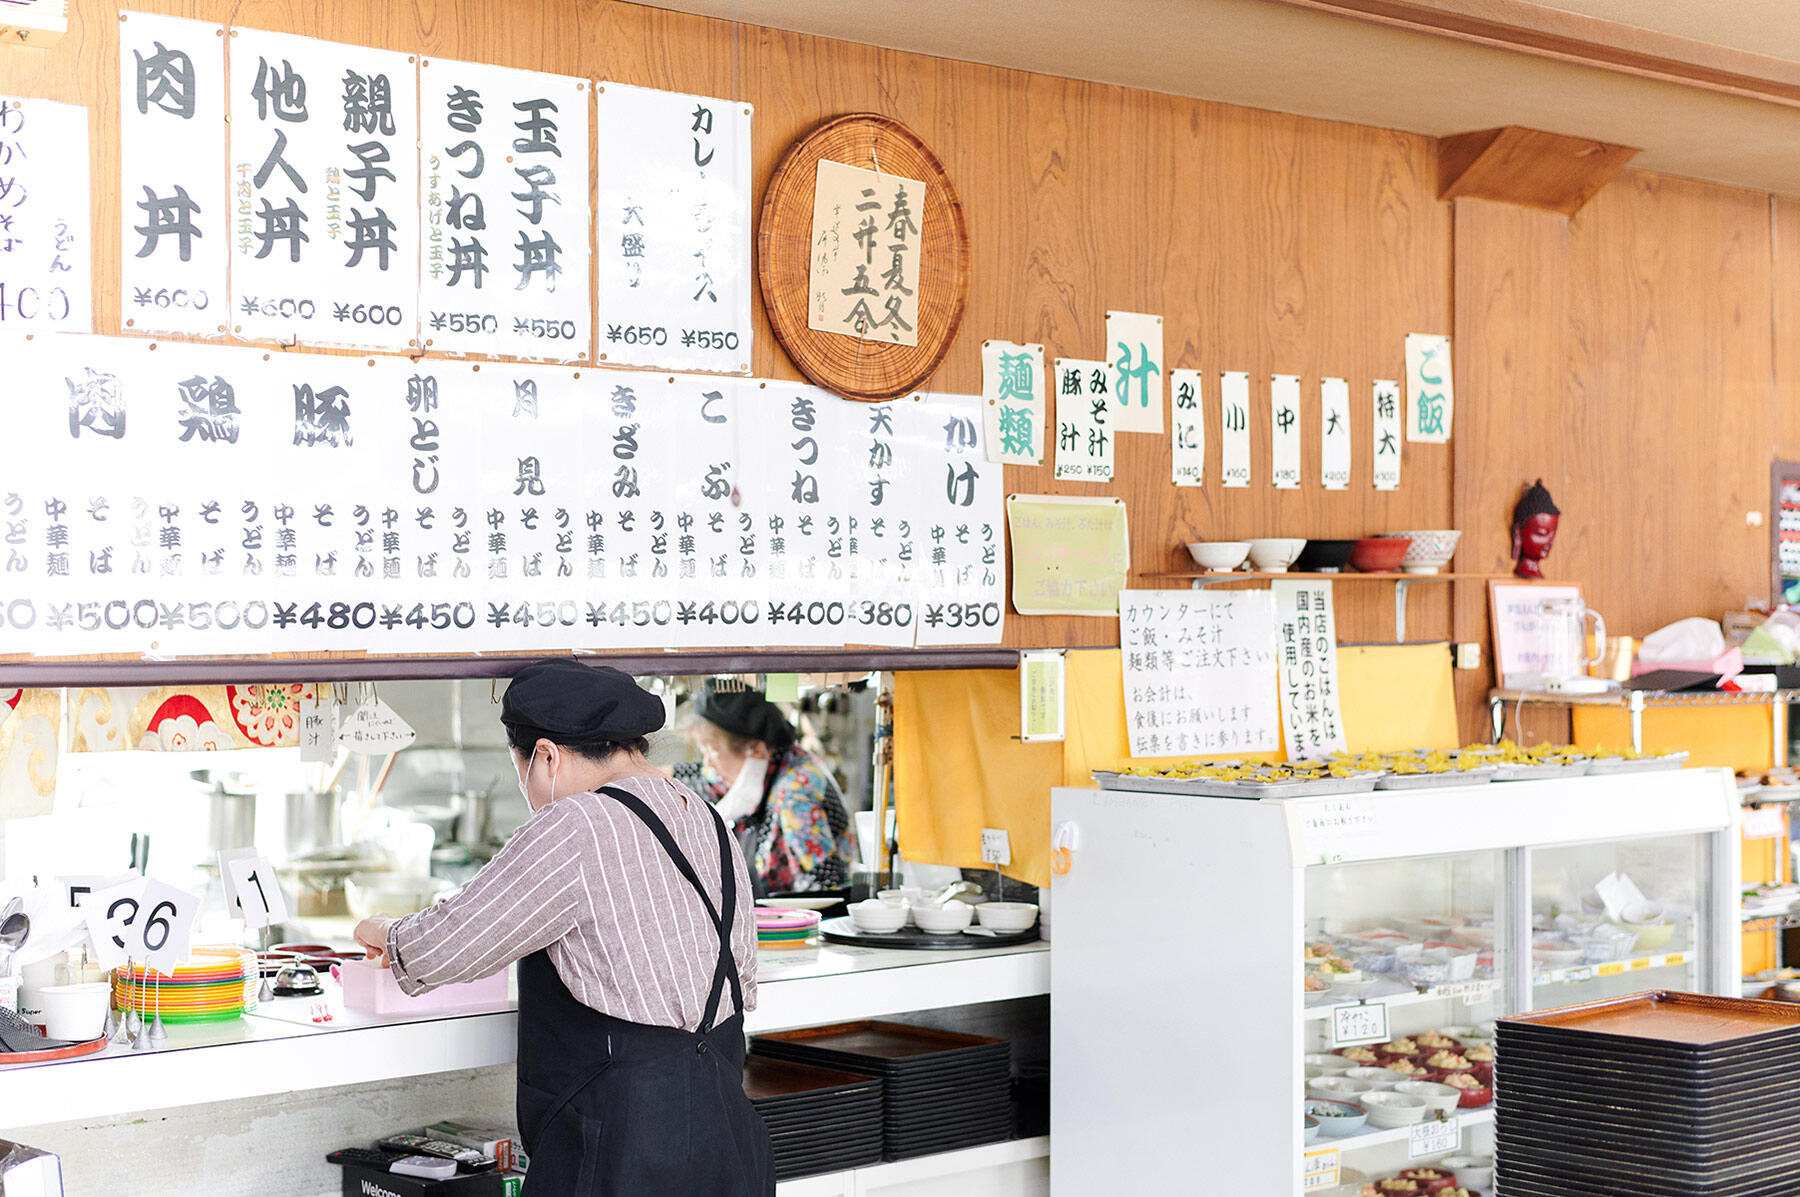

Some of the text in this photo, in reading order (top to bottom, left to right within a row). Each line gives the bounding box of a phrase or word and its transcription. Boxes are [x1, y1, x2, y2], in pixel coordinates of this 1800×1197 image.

[133, 41, 203, 262] 肉丼
[251, 56, 309, 262] 他人丼
[342, 69, 397, 271] 親子丼
[445, 85, 489, 289] きつね丼
[511, 98, 563, 293] 玉子丼
[49, 218, 72, 273] うどん
[879, 184, 918, 341] 春夏冬
[134, 287, 208, 310] ¥600
[241, 296, 316, 320] ¥600
[333, 303, 402, 325] ¥600
[430, 312, 497, 334] ¥550
[513, 317, 576, 339] ¥550
[606, 324, 667, 346] ¥650
[681, 329, 738, 350] ¥550
[998, 350, 1034, 457] 麺類
[1116, 342, 1161, 408] 汁
[1418, 343, 1446, 435] ご飯
[178, 375, 240, 444] 鶏
[292, 383, 353, 448] 豚
[406, 374, 440, 495] 卵とじ
[512, 379, 546, 496] 月見
[611, 385, 640, 499] きざみ
[1062, 369, 1082, 451] 豚汁
[1088, 369, 1108, 456] みそ汁
[1276, 404, 1294, 434] 中
[1328, 408, 1344, 435] 大
[1378, 392, 1396, 455] 特大
[701, 391, 731, 500] こぶ
[791, 396, 820, 504] きつね
[869, 405, 893, 506] 天かす
[943, 416, 979, 507] かけ
[1057, 465, 1082, 474] ¥250
[1087, 466, 1111, 476] ¥150
[4, 492, 28, 573] うどん
[45, 496, 70, 576] 中華麺
[86, 496, 113, 575] そば
[199, 499, 226, 576] そば
[241, 500, 264, 576] うどん
[313, 503, 338, 577] そば
[353, 505, 375, 578] うどん
[382, 506, 400, 579] 中華麺
[414, 506, 438, 579] そば
[452, 507, 470, 579] うどん
[487, 507, 507, 579] 中華麺
[521, 507, 542, 578] そば
[555, 507, 573, 578] うどん
[586, 510, 604, 579] 中華麺
[617, 510, 638, 578] そば
[650, 511, 668, 578] うどん
[677, 512, 697, 579] 中華麺
[707, 512, 728, 578] そば
[739, 512, 756, 578] うどん
[797, 515, 816, 579] そば
[826, 516, 843, 581] うどん
[981, 523, 996, 586] うどん
[46, 599, 158, 630] ¥500
[160, 600, 268, 630] ¥500
[273, 601, 376, 629] ¥480
[380, 602, 476, 630] ¥450
[486, 600, 578, 627] ¥450
[586, 600, 672, 627] ¥450
[677, 600, 759, 625] ¥400
[768, 601, 844, 626] ¥400
[925, 602, 999, 628] ¥350
[1127, 602, 1233, 622] カウンターにて
[1129, 648, 1269, 671] 麺類等ご注文下さい
[1297, 590, 1320, 747] 国内産のお米を
[1314, 590, 1336, 740] 当店のごはんは
[1134, 705, 1250, 728] 食後にお願いします
[248, 870, 269, 912] 1
[143, 901, 176, 951] 6
